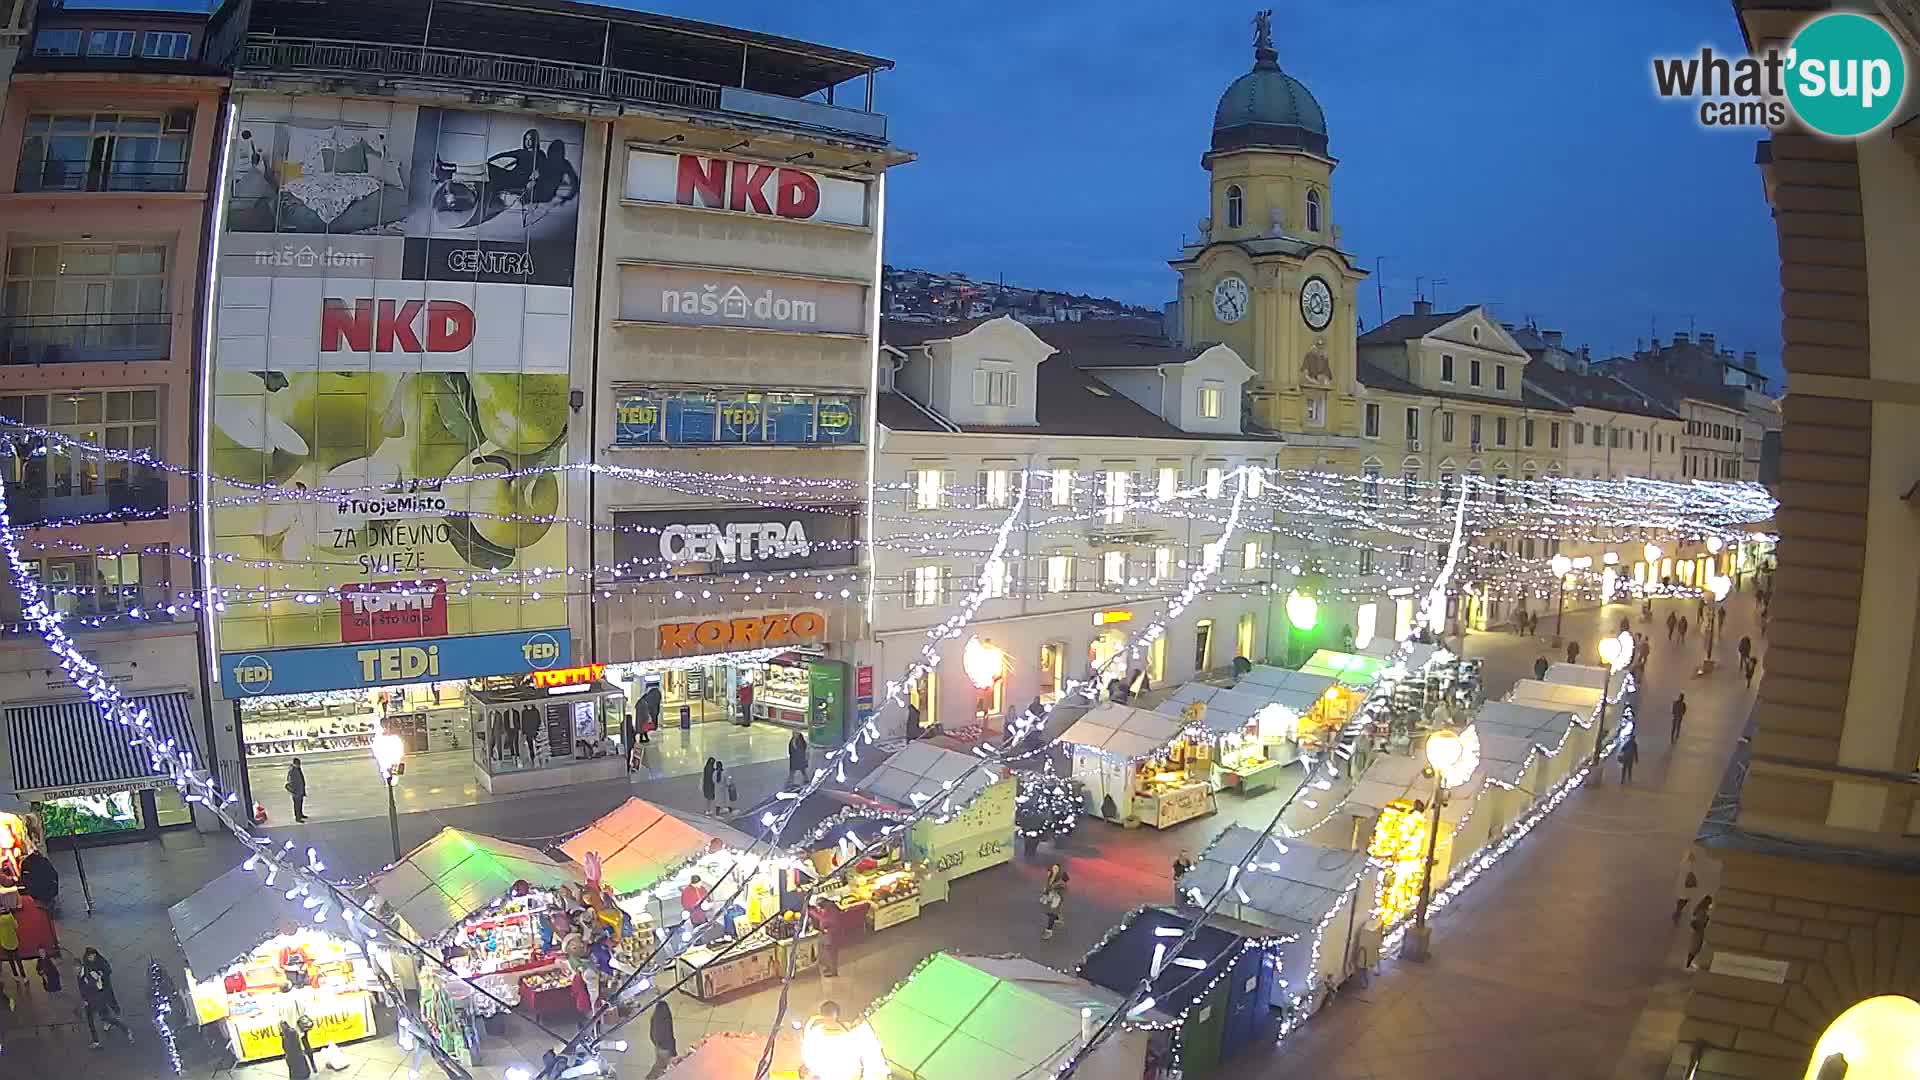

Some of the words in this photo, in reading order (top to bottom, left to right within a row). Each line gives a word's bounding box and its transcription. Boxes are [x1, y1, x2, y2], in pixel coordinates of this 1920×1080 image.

[676, 153, 820, 219] NKD
[255, 246, 294, 266] naš
[319, 246, 367, 267] dom
[448, 249, 535, 274] CENTRA
[662, 283, 718, 315] naš
[754, 289, 816, 322] dom
[320, 298, 476, 353] NKD
[619, 407, 657, 425] TEDi
[338, 497, 446, 516] #TvojeMisto
[333, 528, 357, 548] ZA
[367, 523, 450, 547] DNEVNO
[659, 520, 810, 563] CENTRA
[359, 547, 425, 575] SVJEŽE
[352, 589, 434, 614] TOMMY
[658, 612, 825, 651] KORZO
[358, 646, 439, 682] TEDi
[522, 644, 560, 660] TEDi
[234, 666, 273, 683] TEDi
[533, 664, 605, 690] TOMMY
